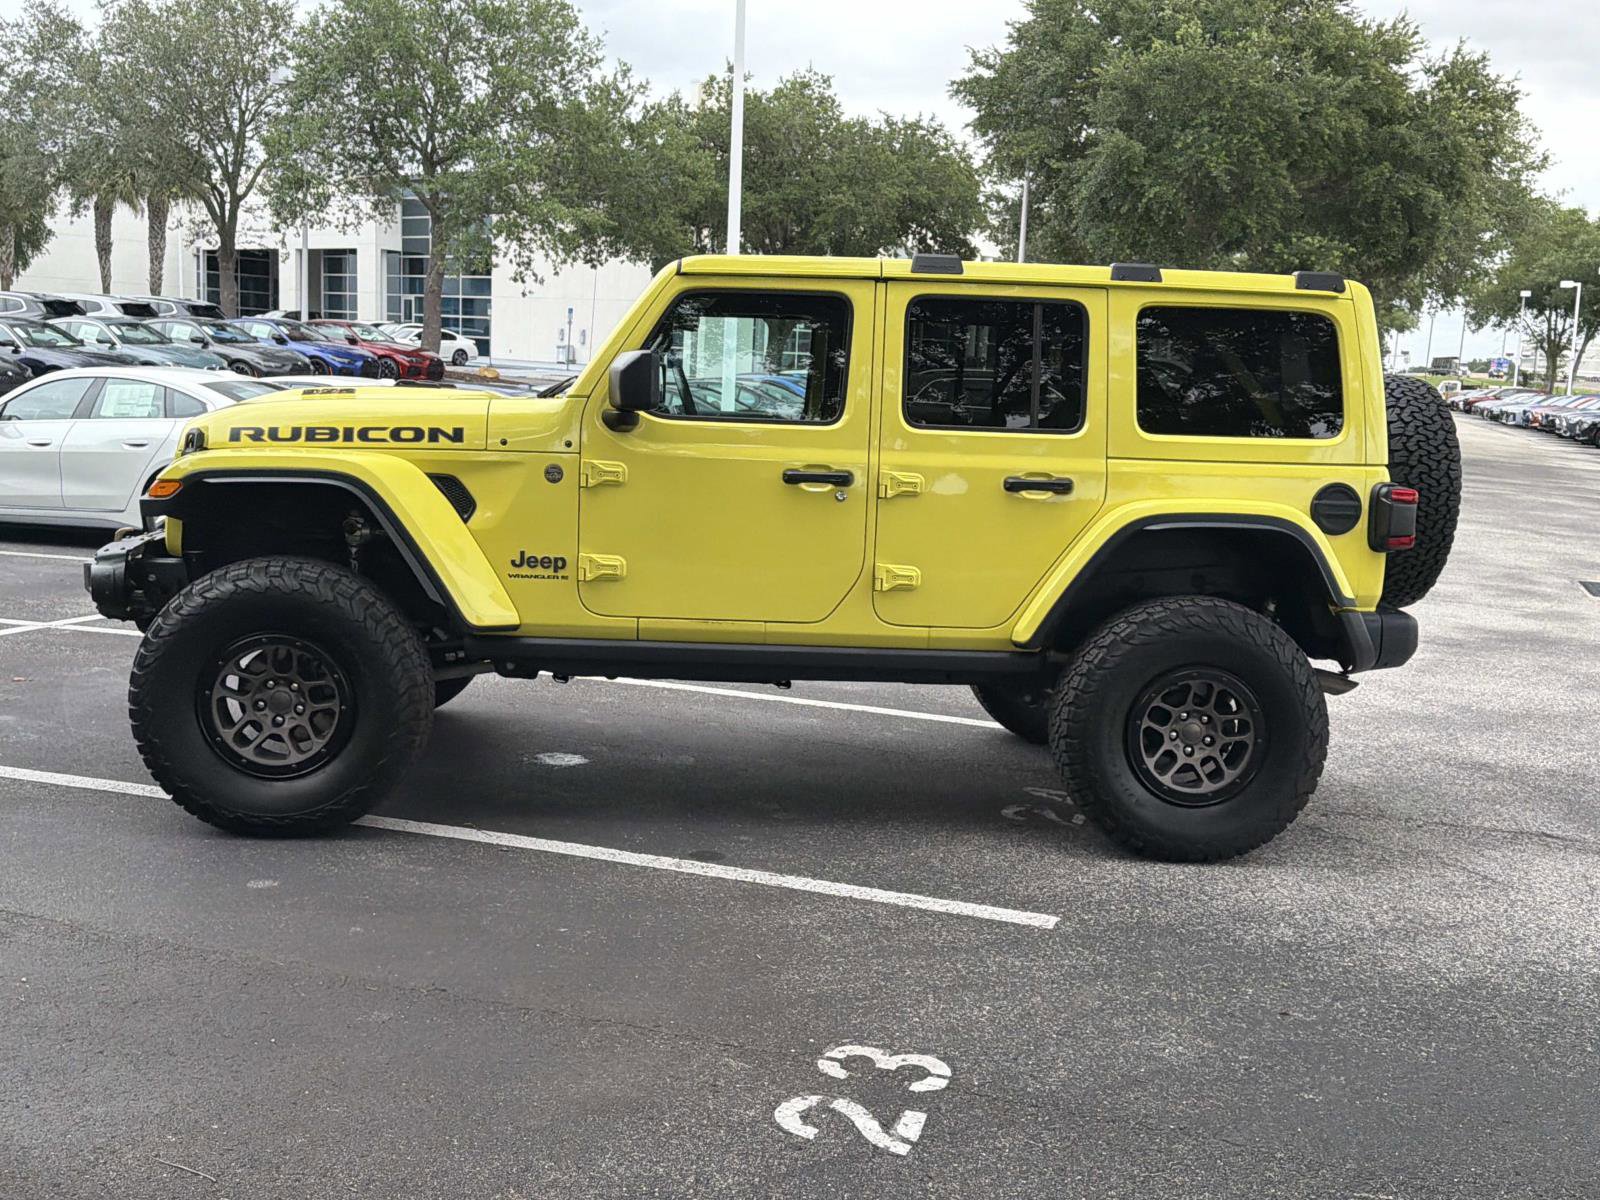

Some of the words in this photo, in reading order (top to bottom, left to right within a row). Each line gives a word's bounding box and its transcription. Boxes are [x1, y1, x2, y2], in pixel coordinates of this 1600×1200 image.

[229, 427, 464, 443] RUBICON
[511, 550, 567, 573] Jeep
[774, 1045, 952, 1156] 23
